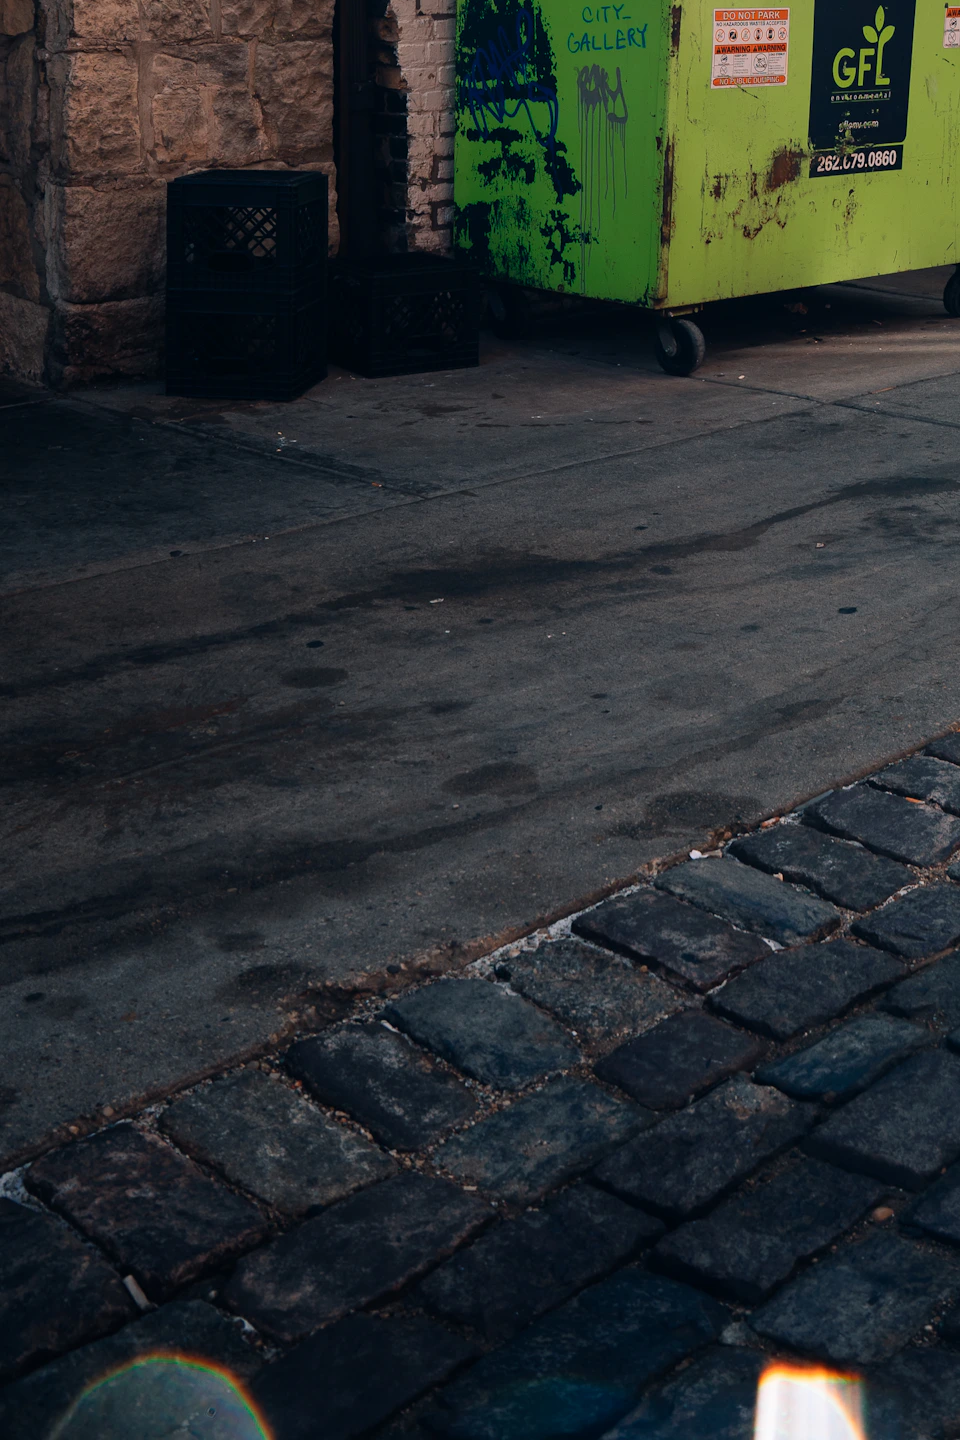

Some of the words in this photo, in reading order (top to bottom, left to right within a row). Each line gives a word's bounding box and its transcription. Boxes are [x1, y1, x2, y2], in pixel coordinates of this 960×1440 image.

[723, 12, 736, 20] DO
[738, 11, 756, 20] NOT
[758, 11, 780, 19] PARK
[567, 23, 649, 54] GALLERY
[757, 44, 786, 52] WARNING
[832, 38, 893, 89] GFL
[754, 76, 780, 84] DUMPING
